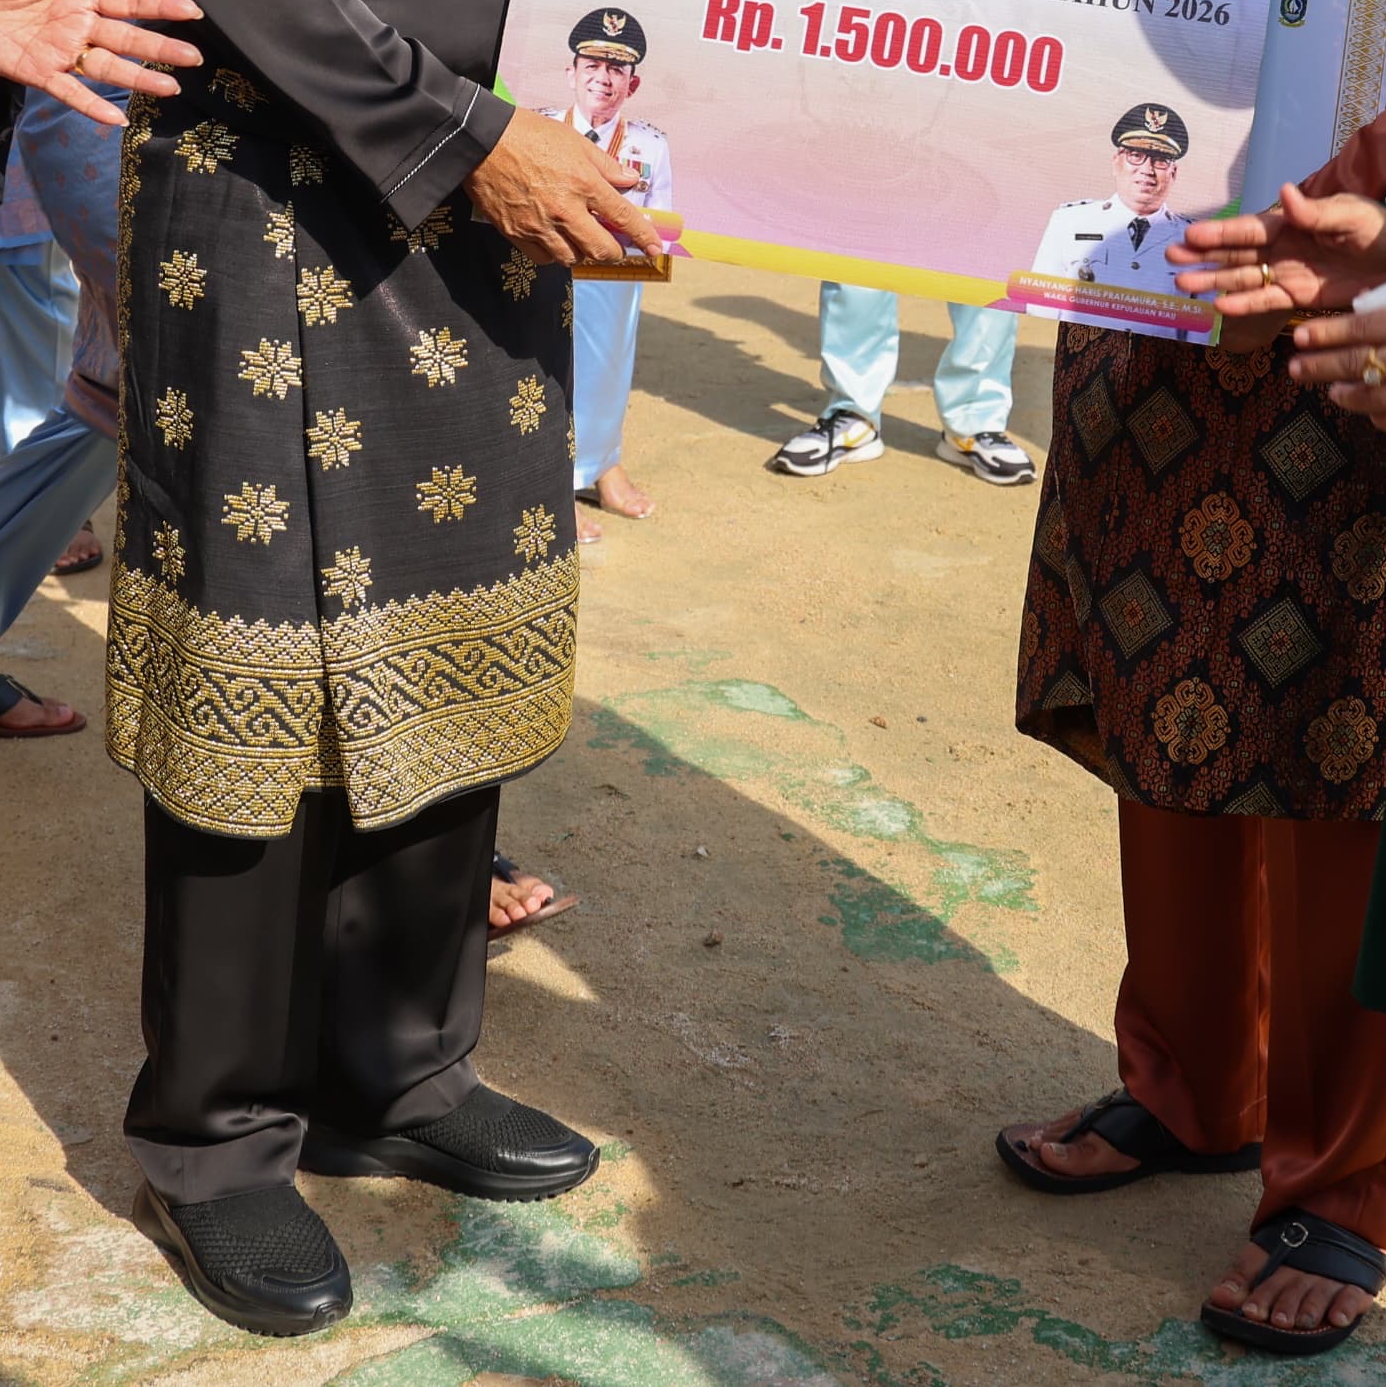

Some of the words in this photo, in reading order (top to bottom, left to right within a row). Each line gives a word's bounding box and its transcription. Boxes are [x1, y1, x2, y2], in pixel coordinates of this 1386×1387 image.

[800, 1, 1064, 93] 1.500.000
[1019, 276, 1073, 293] NYANYANG
[1075, 285, 1102, 299] HARIS
[1068, 295, 1110, 309] GUBERNUR
[1111, 302, 1157, 317] KEPULAUAN
[1158, 311, 1177, 320] RIAU
